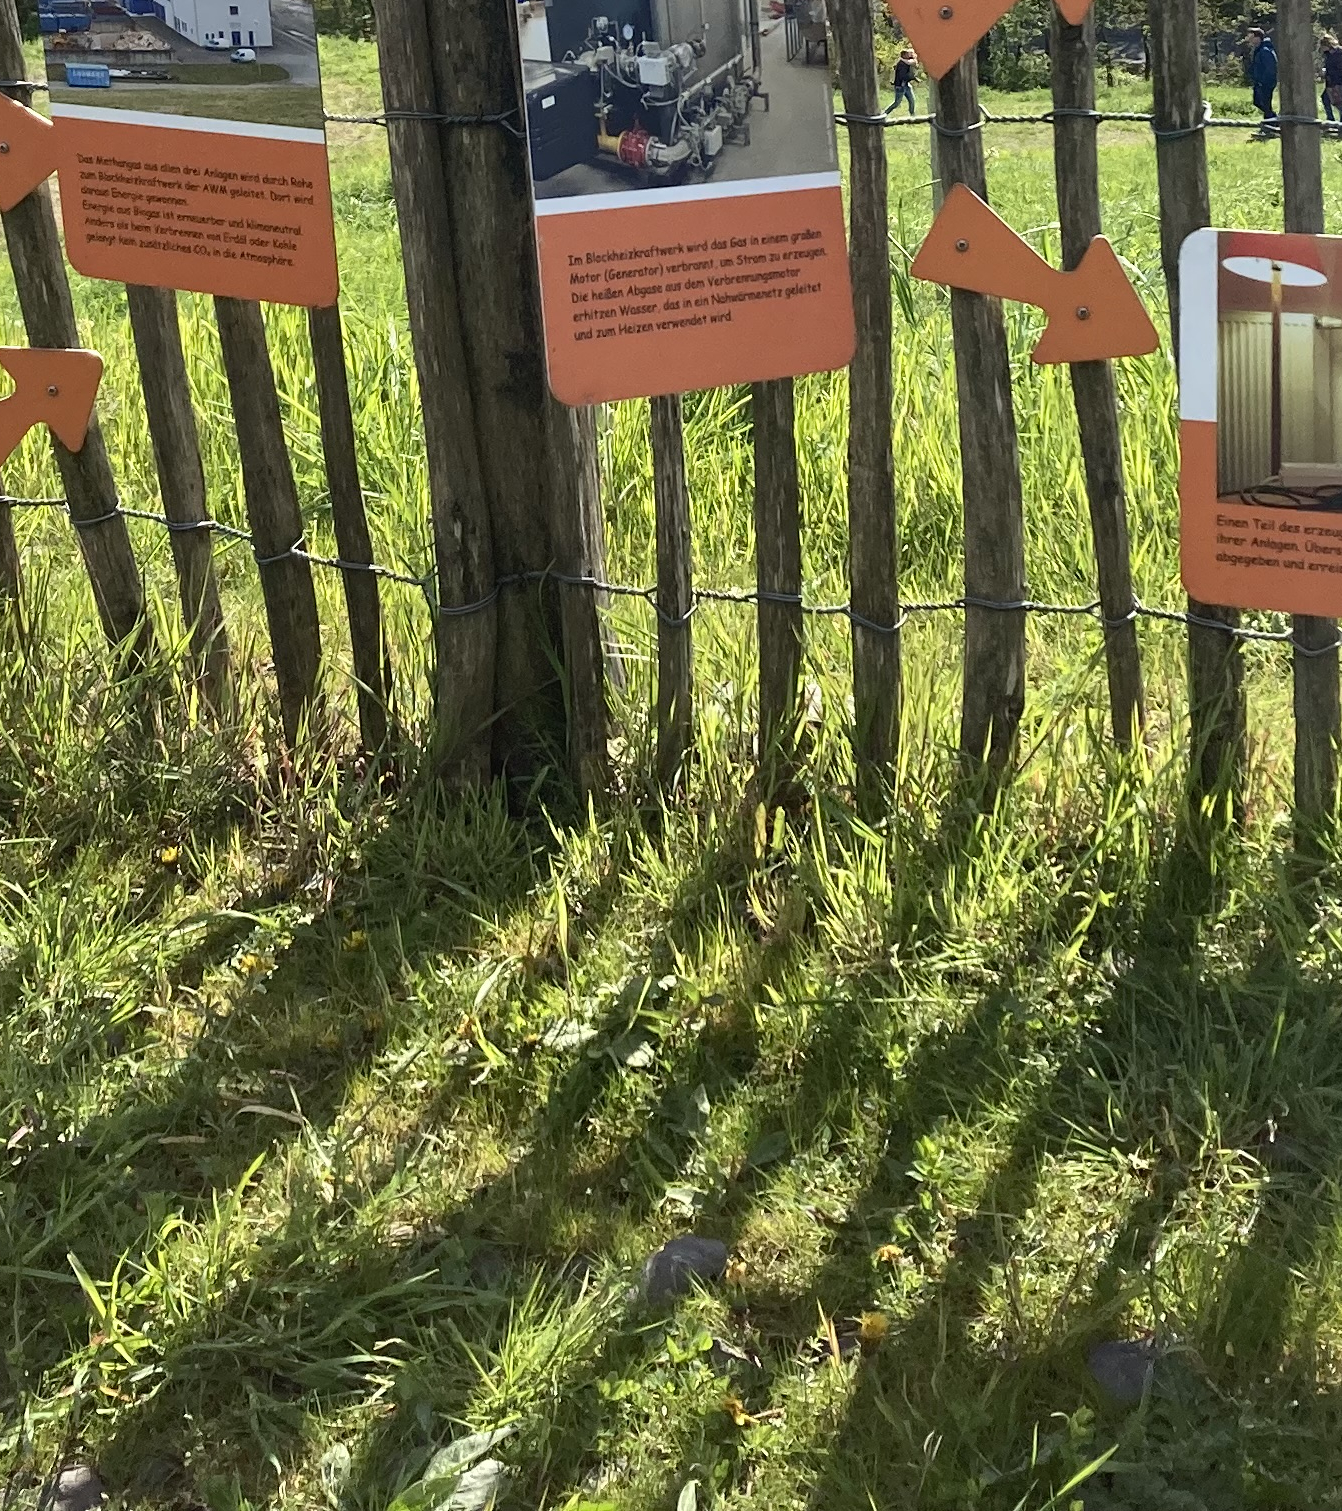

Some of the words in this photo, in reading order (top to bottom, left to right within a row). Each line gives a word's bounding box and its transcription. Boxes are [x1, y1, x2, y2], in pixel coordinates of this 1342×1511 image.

[568, 255, 583, 267] Im
[586, 243, 684, 265] Blockheizkraftwerk
[687, 240, 709, 253] wird
[711, 239, 728, 251] das
[730, 237, 747, 249] Gas
[750, 235, 759, 246] in
[761, 234, 789, 245] einem
[791, 229, 822, 244] großen
[570, 272, 601, 285] Motor
[604, 263, 664, 284] (Generator)
[720, 258, 734, 268] um
[737, 254, 767, 266] Strom
[769, 252, 781, 262] zu
[571, 292, 589, 304] Die
[591, 288, 624, 302] heißen
[627, 284, 663, 298] Abgase
[665, 282, 682, 293] aus
[684, 279, 705, 290] dem
[708, 266, 801, 287] Verbrennungsmotor
[573, 309, 617, 322] erhitzen
[663, 300, 680, 311] das
[683, 298, 693, 309] in
[694, 296, 709, 307] ein
[711, 286, 783, 305] Nahwärmenetz
[785, 281, 822, 299] geleitet
[574, 328, 593, 342] und
[596, 328, 616, 339] zum
[618, 323, 654, 336] Heizen
[656, 313, 707, 331] verwendet
